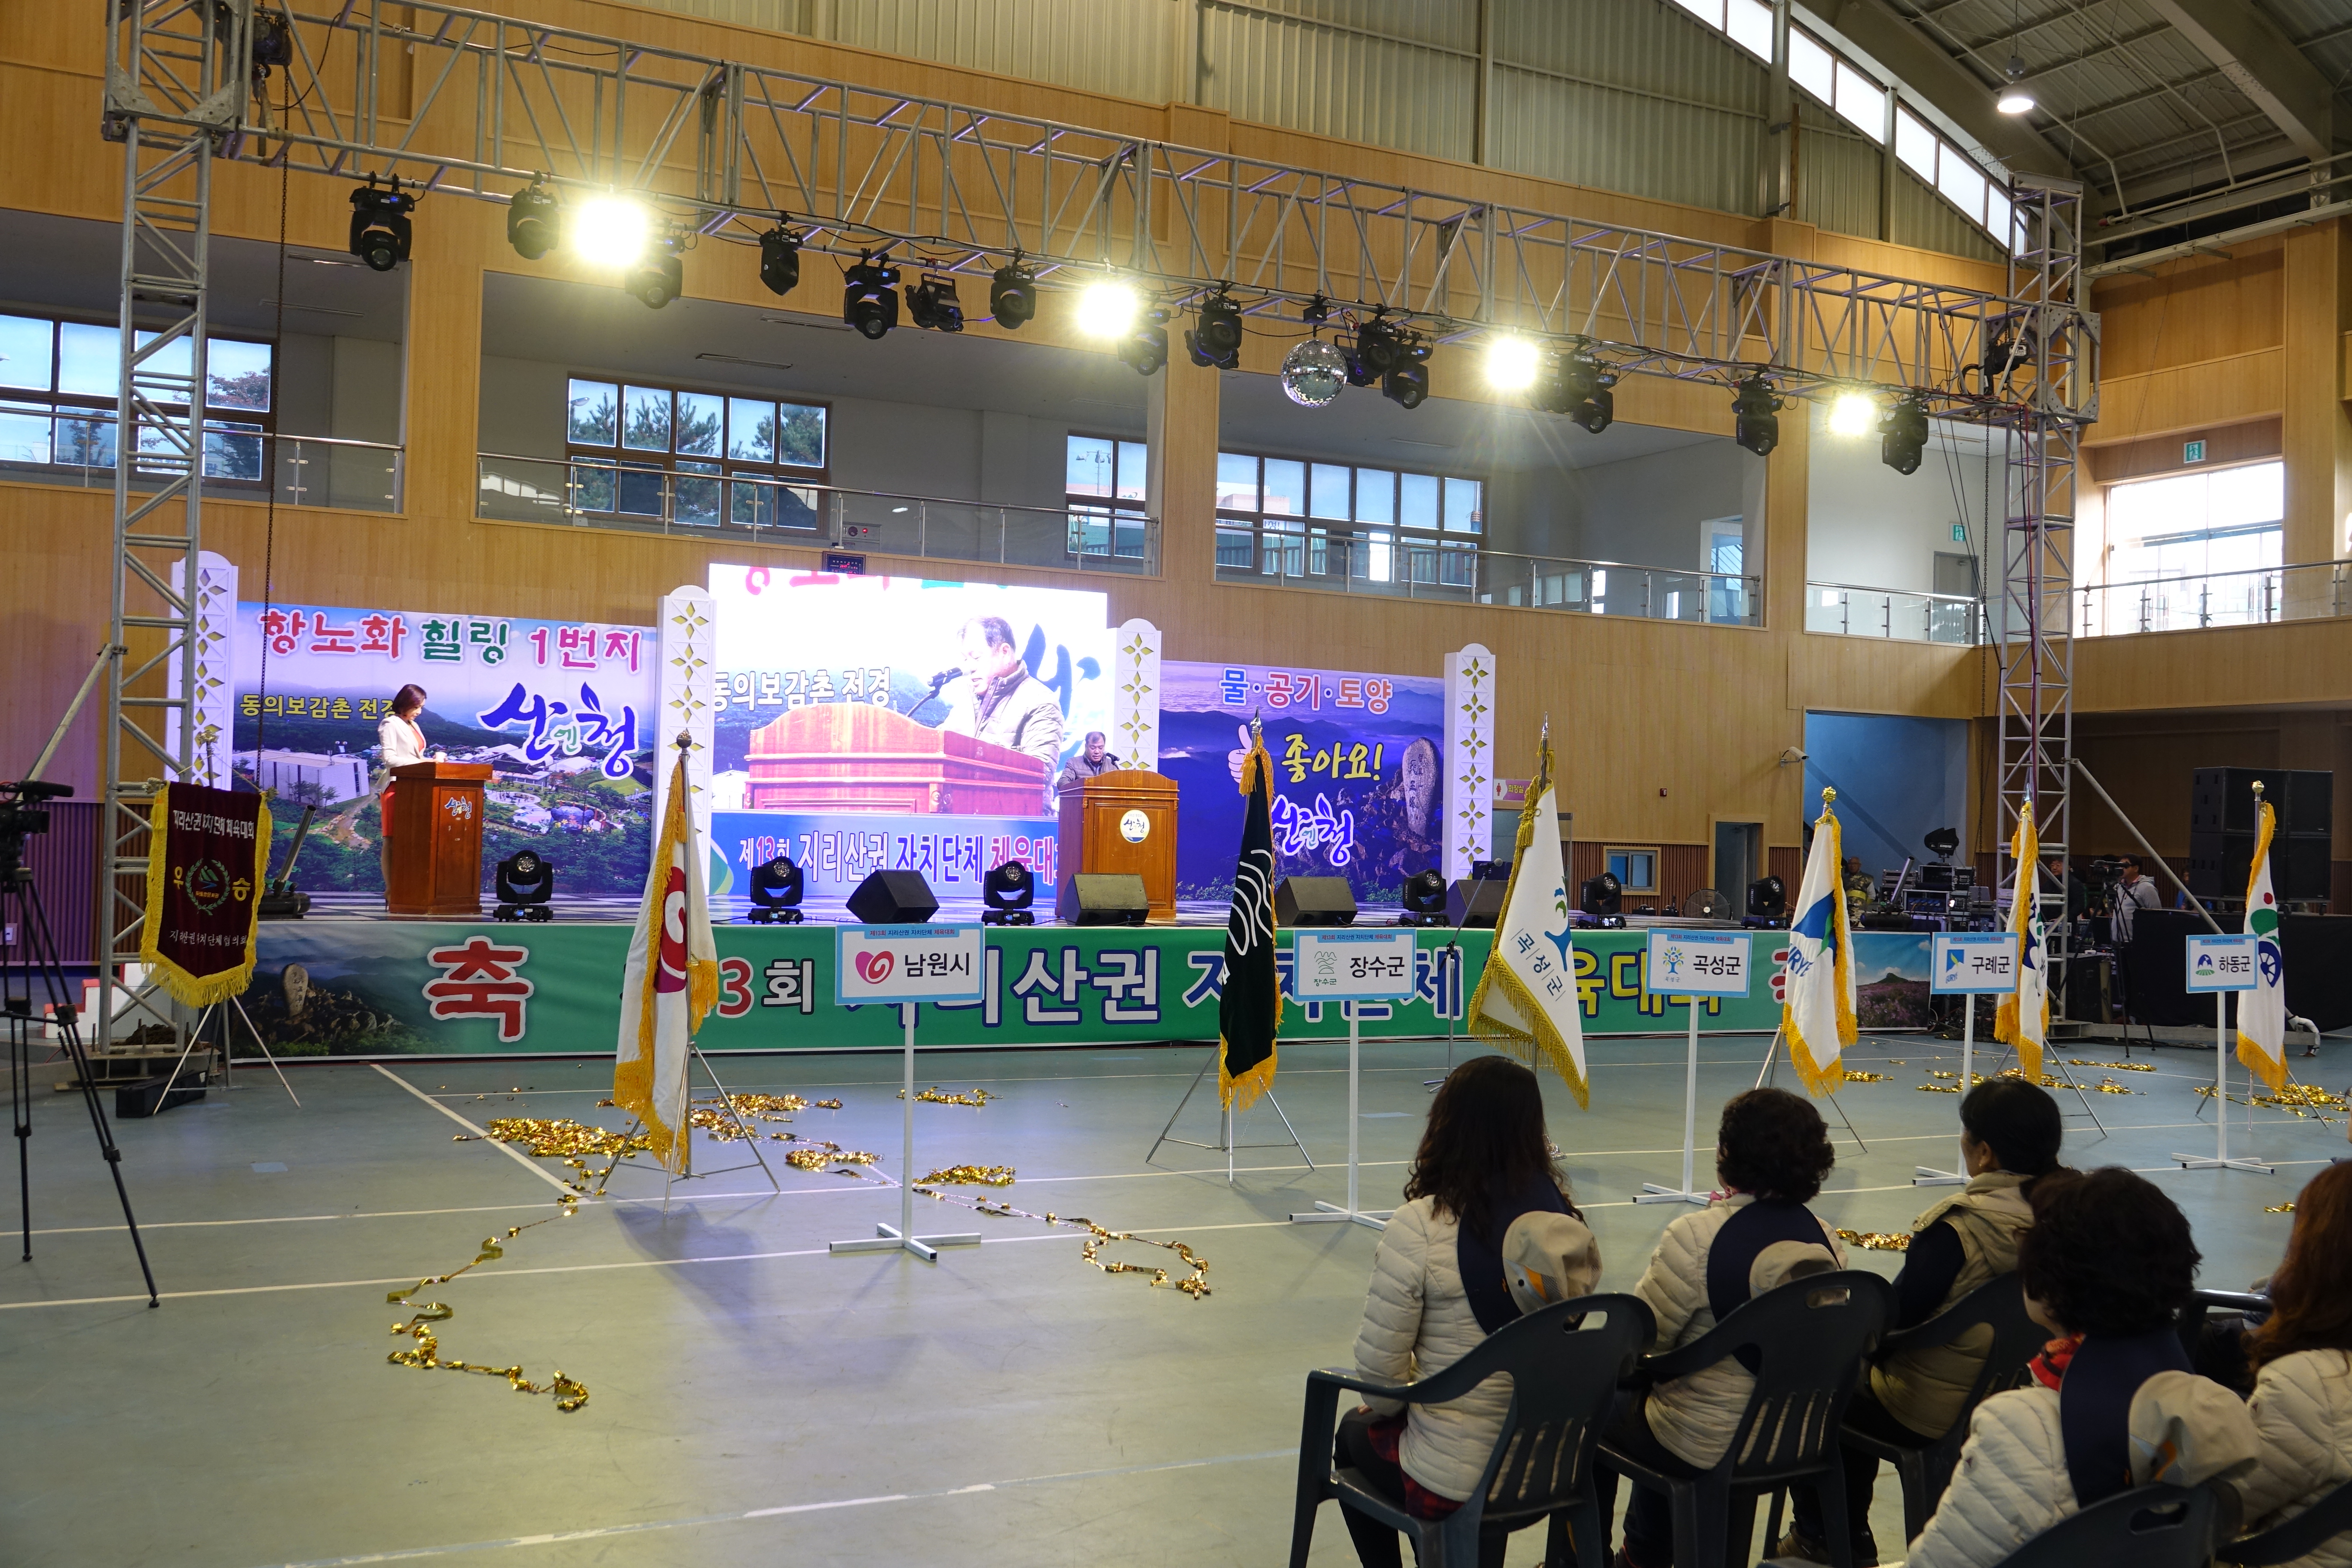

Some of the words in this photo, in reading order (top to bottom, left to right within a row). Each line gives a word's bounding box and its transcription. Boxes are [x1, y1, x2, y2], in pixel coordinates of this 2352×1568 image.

[260, 609, 407, 661] 항노화
[421, 619, 510, 664] 힐링
[530, 627, 642, 672] 1번지
[714, 669, 835, 712] 동의보감촌
[841, 667, 890, 707] 전경
[240, 694, 352, 719] 동의보감촌
[1282, 734, 1384, 782] 좋아요!
[1508, 784, 1524, 794] 화장실
[797, 830, 888, 882] 지리산권
[895, 833, 983, 883] 자치단체
[989, 835, 1058, 885] 체육대
[173, 866, 184, 889] 우
[232, 877, 251, 901] 승
[904, 952, 969, 977] 남원시
[1350, 956, 1405, 978] 장수군
[1516, 932, 1563, 996] 곡성군
[1693, 955, 1741, 975] 곡성군
[1972, 956, 2010, 974] 구례군
[2219, 956, 2251, 973] 하동군
[423, 935, 534, 1042] 축
[1314, 978, 1337, 987] 장수군
